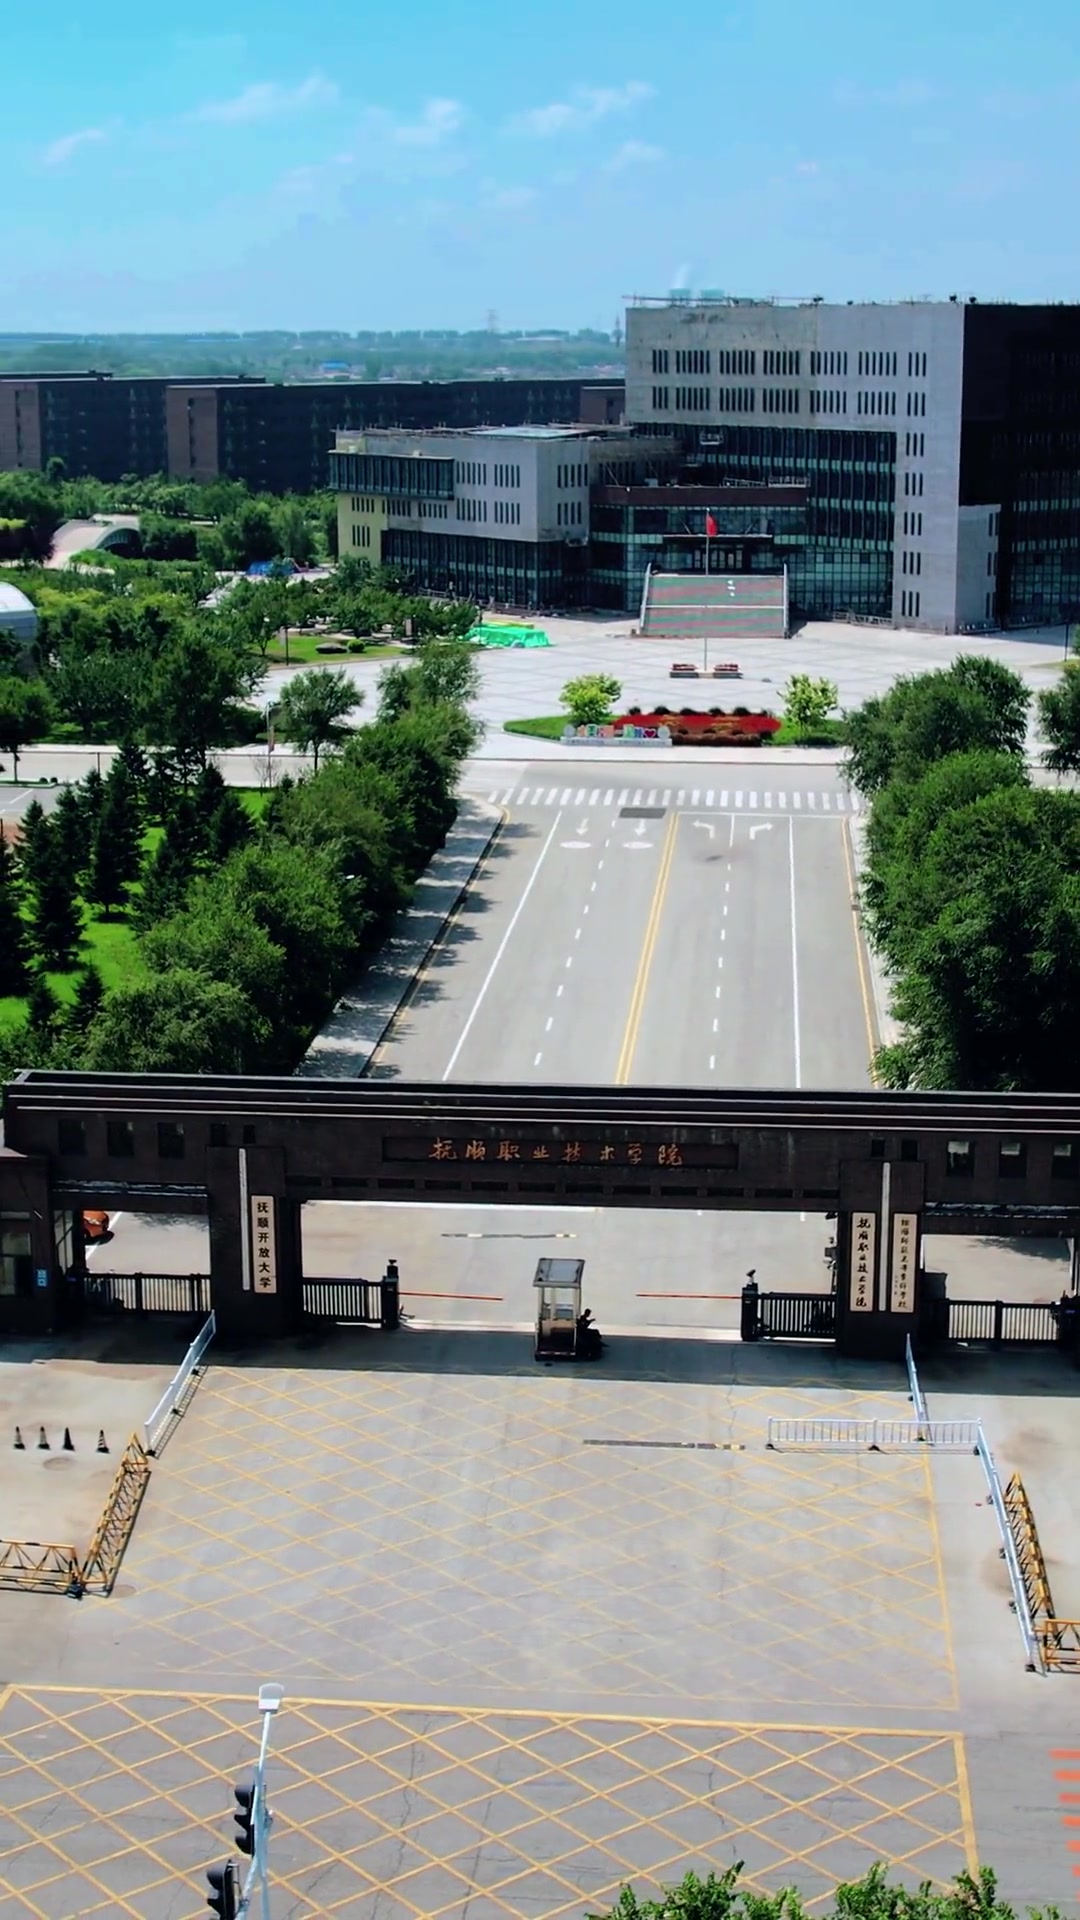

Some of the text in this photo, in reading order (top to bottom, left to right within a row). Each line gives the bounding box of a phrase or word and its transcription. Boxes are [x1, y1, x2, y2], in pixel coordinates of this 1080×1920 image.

[428, 1137, 683, 1166] 抚顺职业技术学院
[256, 1202, 272, 1288] 抚顺开放大学
